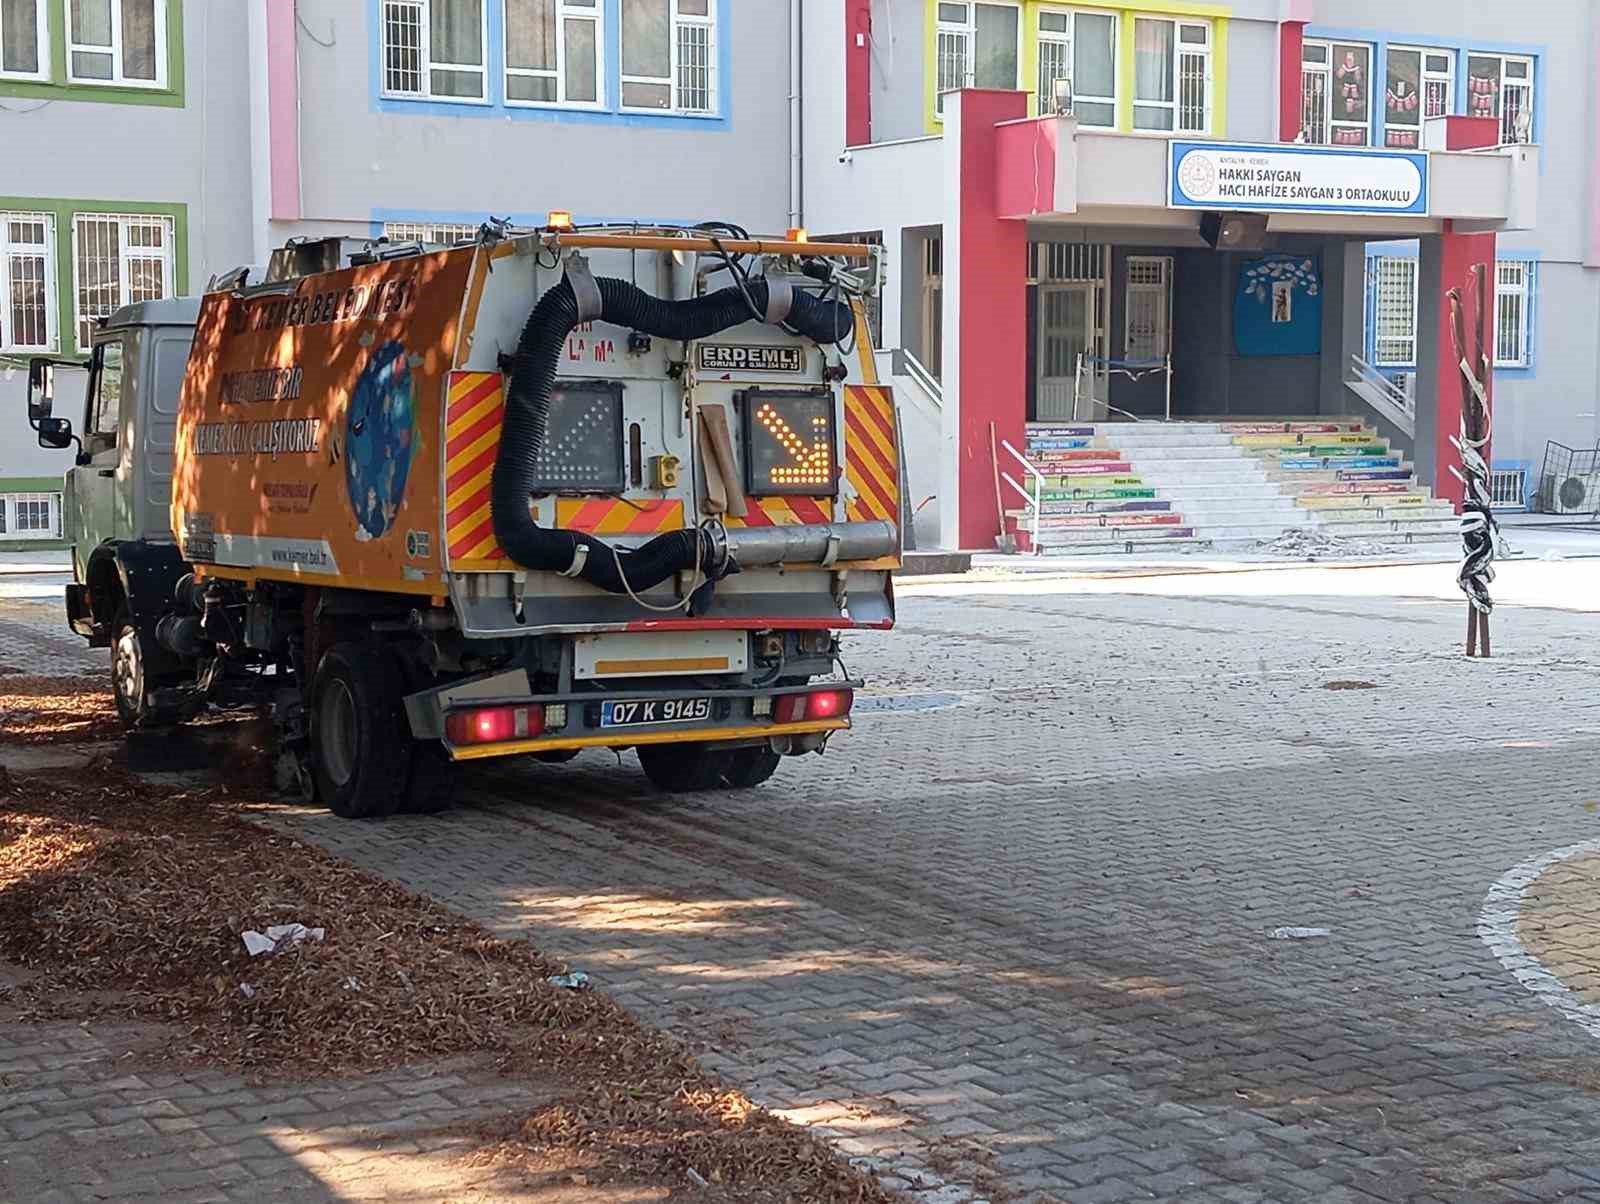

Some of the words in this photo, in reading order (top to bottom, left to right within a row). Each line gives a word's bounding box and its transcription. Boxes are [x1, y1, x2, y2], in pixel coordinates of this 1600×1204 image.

[1219, 169, 1254, 181] HAKKI
[1257, 170, 1301, 182] SAYGAN
[1218, 184, 1246, 197] HACI
[1249, 183, 1288, 198] HAFİZE
[1290, 187, 1334, 199] SAYGAN
[1337, 188, 1343, 199] 3
[1345, 188, 1410, 201] ORTAOKULU
[613, 702, 638, 723] 07
[643, 702, 656, 721] K
[663, 698, 707, 719] 9145
